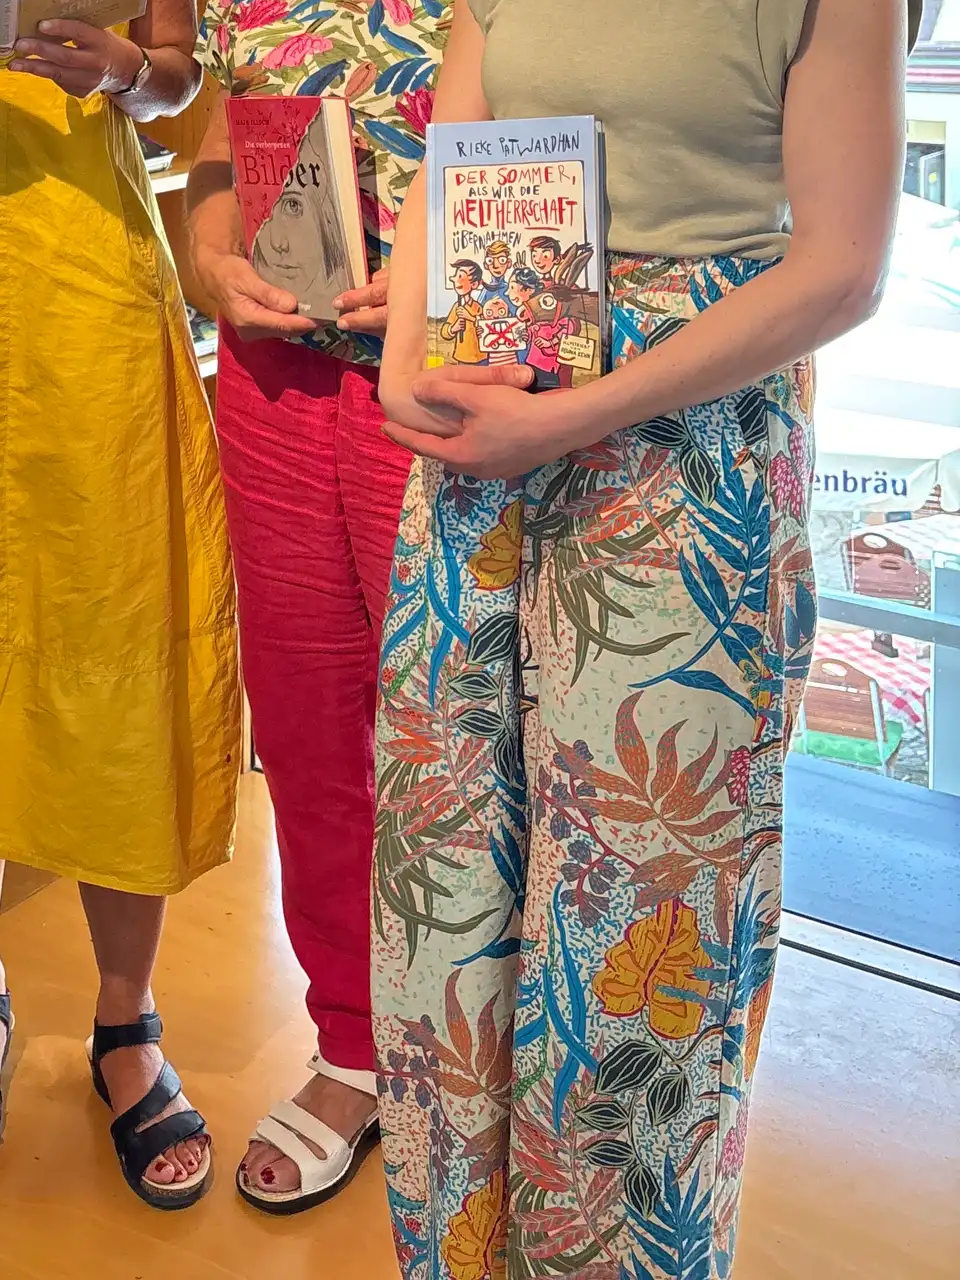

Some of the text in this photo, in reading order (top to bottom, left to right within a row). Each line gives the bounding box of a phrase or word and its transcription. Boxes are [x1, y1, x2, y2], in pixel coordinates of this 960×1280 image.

[456, 130, 580, 158] RIEKE PATWARDHAN
[240, 154, 321, 189] Bilder
[455, 165, 576, 187] DER SOMMER,
[468, 184, 540, 199] ALS WIR DIE
[453, 196, 578, 229] WELTHERRSCHAFT
[452, 231, 522, 254] ÜBERNAHMEN
